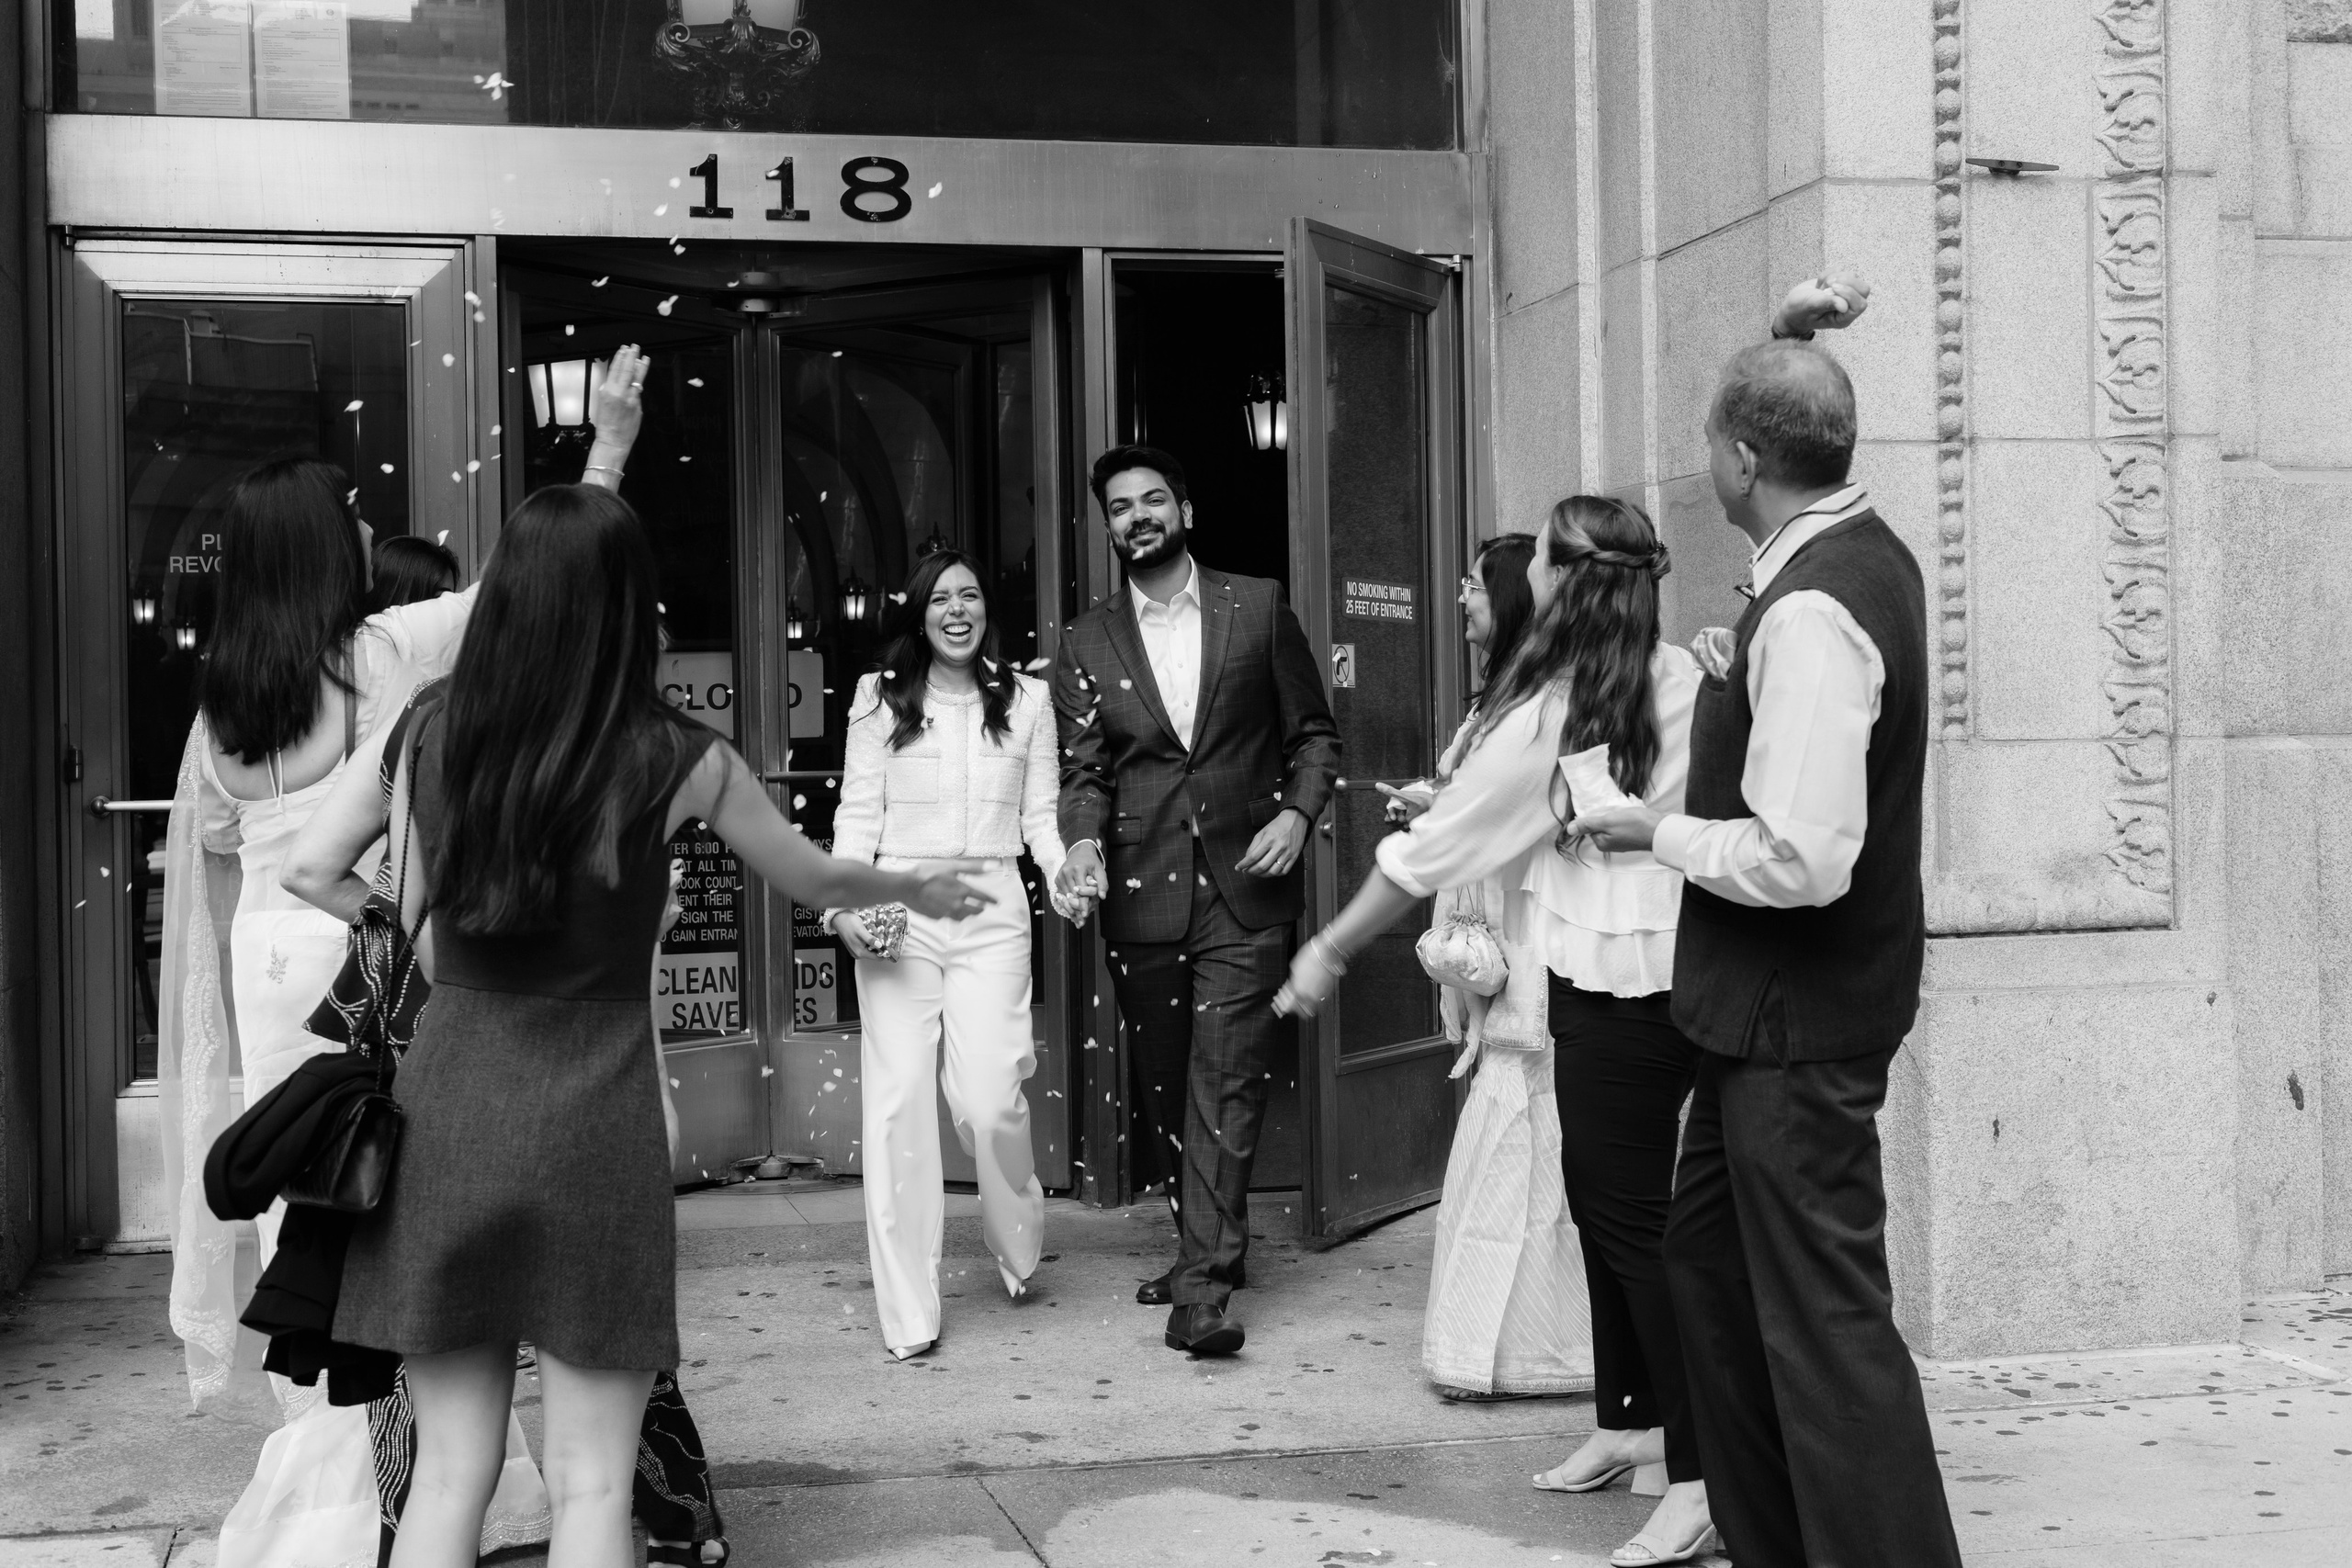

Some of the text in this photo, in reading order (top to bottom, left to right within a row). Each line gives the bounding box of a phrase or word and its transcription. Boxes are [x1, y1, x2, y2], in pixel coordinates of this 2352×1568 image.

[689, 153, 912, 223] 118
[1347, 581, 1411, 602] NO SMOKING WITHIN
[1346, 599, 1413, 619] 25 FEET OF ENTRANCE
[695, 841, 719, 854] 6:00
[697, 860, 716, 873] ALL
[705, 875, 737, 889] COUNT
[678, 893, 732, 907] ENT THEIR
[681, 911, 707, 924] SIGN
[712, 910, 734, 923] THE
[672, 929, 696, 942] GAIN
[658, 965, 738, 996] CLEAN
[672, 1000, 740, 1030] SAVE
